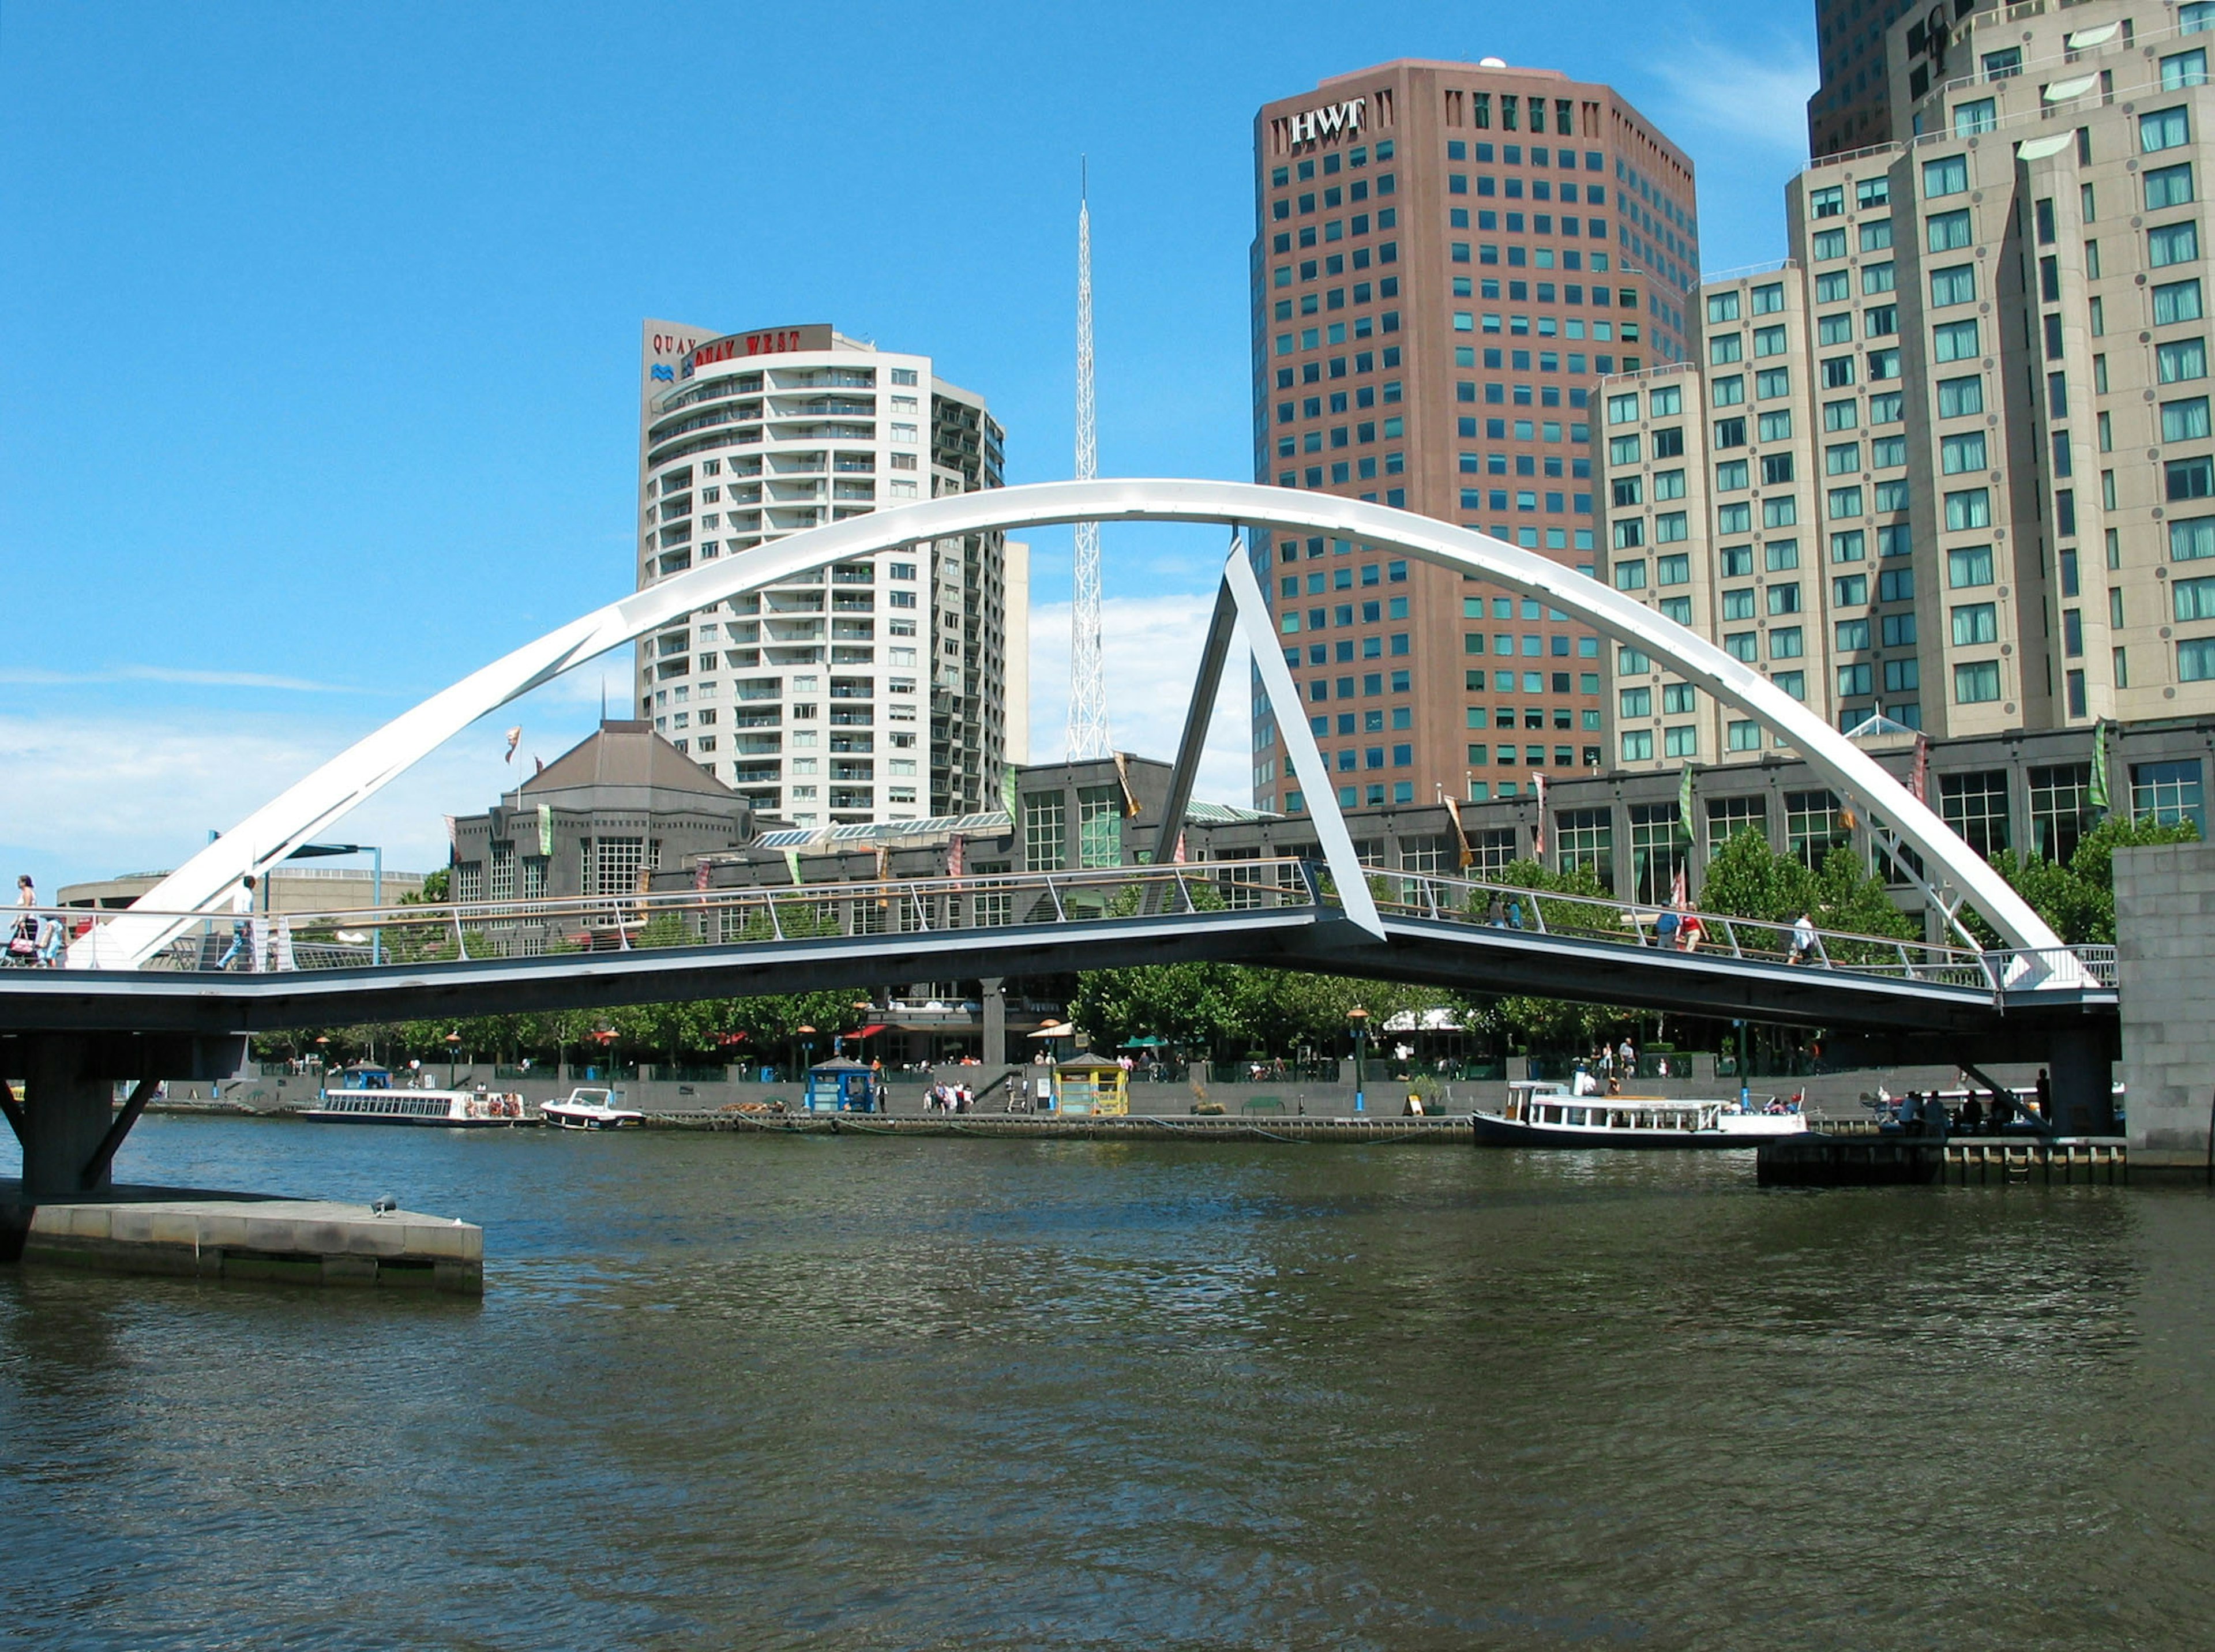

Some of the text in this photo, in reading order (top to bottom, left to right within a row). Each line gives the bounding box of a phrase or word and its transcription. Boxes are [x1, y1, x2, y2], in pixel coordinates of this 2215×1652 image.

[1292, 98, 1365, 142] HWT
[654, 333, 696, 355] QUAY
[696, 332, 800, 366] QUAY WEST
